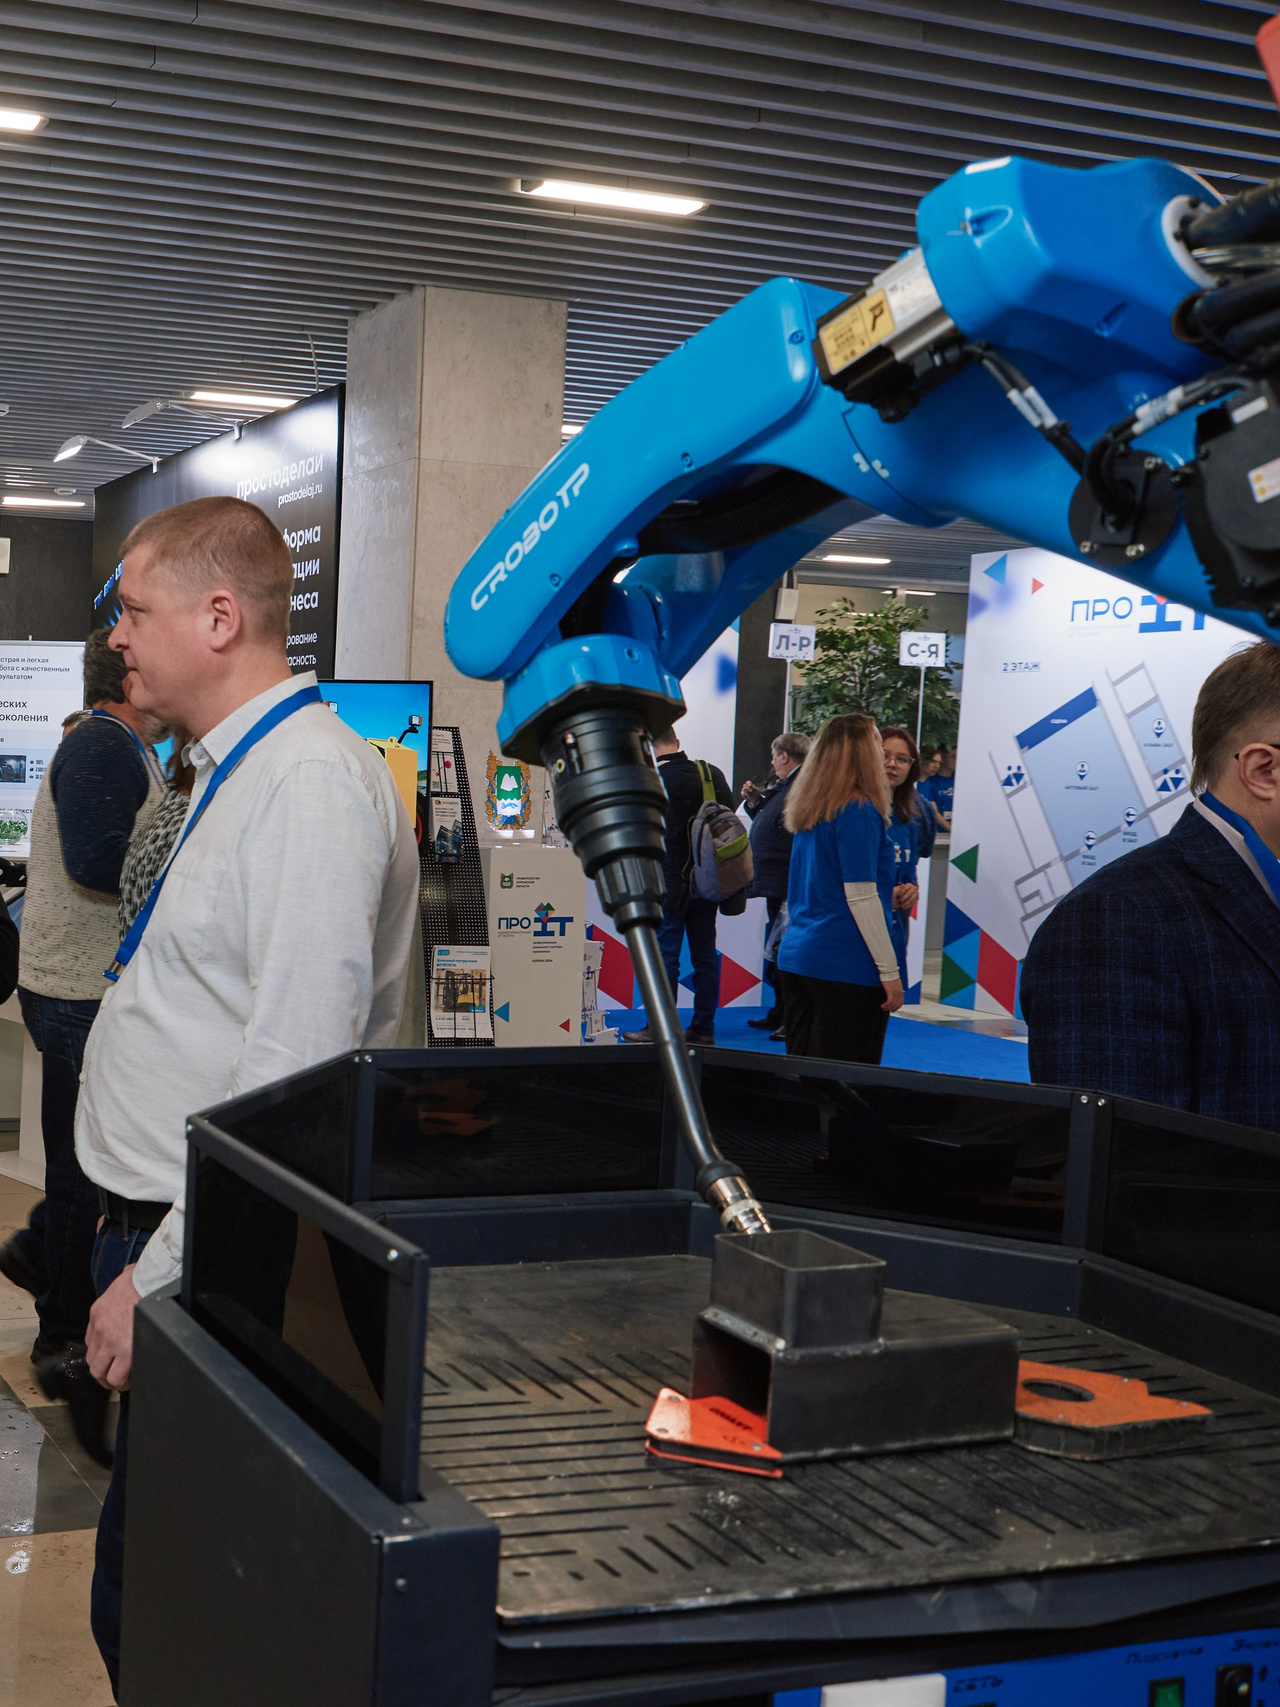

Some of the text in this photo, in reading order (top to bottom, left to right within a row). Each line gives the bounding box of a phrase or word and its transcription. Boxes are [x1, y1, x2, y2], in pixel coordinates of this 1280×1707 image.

[277, 482, 323, 508] prostodelaj.ru
[1070, 596, 1133, 622] ПРО
[775, 634, 812, 652] Л-Р
[907, 642, 940, 658] С-Я
[286, 654, 317, 667] асность
[1002, 661, 1041, 672] 2 ЭТАЖ
[498, 917, 531, 930] ПРО
